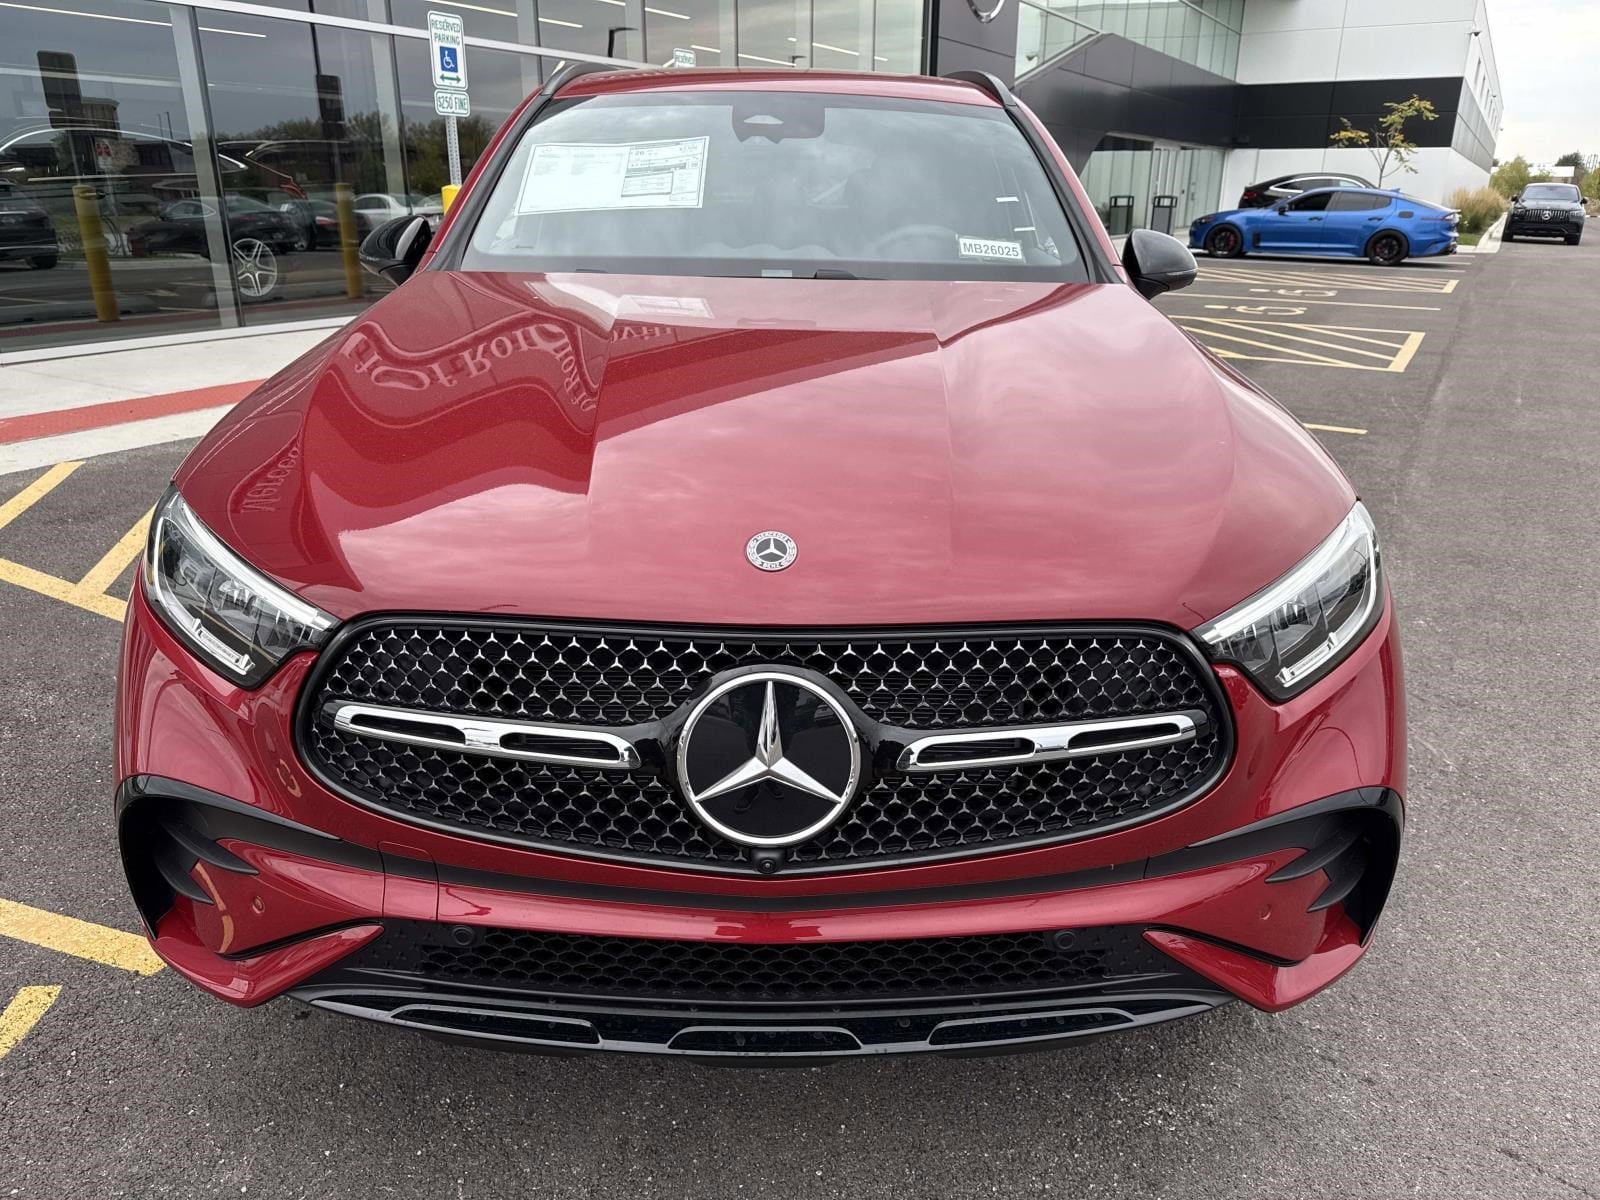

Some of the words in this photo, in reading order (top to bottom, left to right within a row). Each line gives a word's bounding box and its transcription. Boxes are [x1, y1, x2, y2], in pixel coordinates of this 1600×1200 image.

[431, 20, 460, 33] RESERVED
[434, 33, 460, 46] PARKING
[438, 96, 453, 110] $250
[454, 97, 467, 111] FINE
[962, 242, 1019, 257] MB26025
